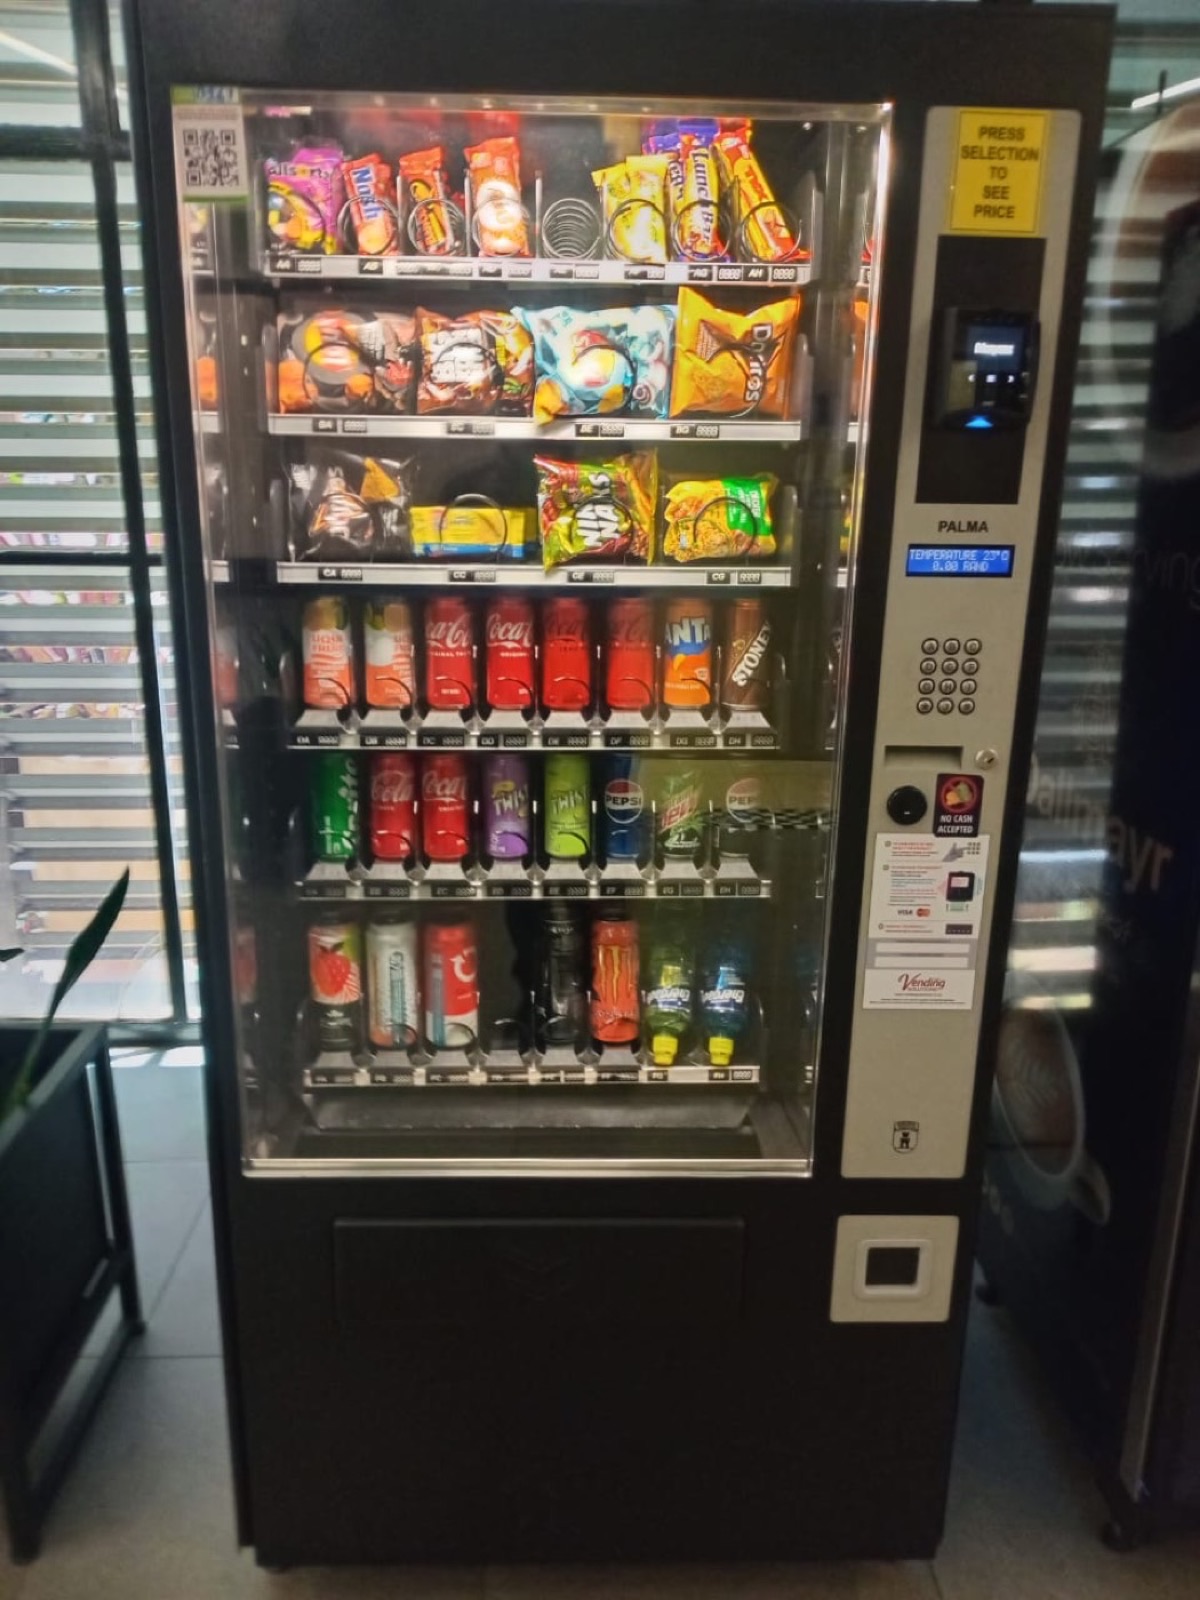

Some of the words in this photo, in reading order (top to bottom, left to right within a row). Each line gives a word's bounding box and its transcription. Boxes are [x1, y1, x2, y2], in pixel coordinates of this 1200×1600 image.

[978, 126, 1025, 141] PRESS
[961, 145, 1039, 161] SELECTION
[989, 165, 1008, 180] TO
[982, 185, 1010, 200] SEE
[973, 204, 1016, 219] PRICE
[937, 520, 989, 533] PALMA
[909, 549, 978, 560] TEMPERATURE
[732, 620, 770, 687] STONEY
[605, 796, 641, 806] PEPSI
[940, 815, 953, 823] NO
[954, 815, 973, 823] CASH
[937, 825, 974, 834] ACCEPTED
[897, 973, 946, 991] Vending
